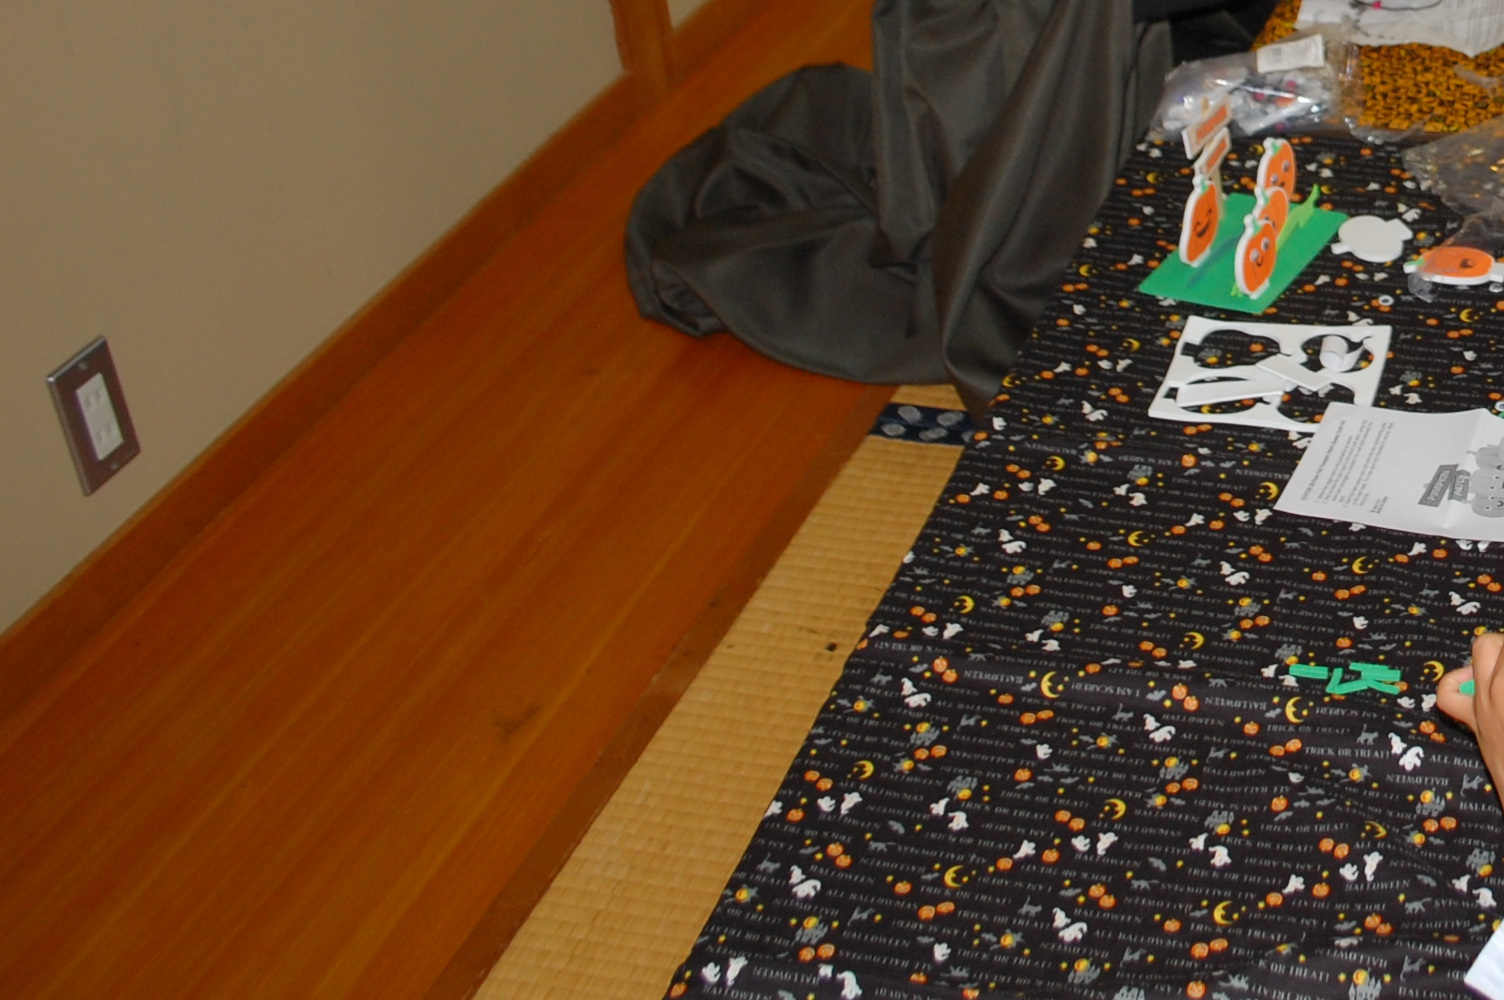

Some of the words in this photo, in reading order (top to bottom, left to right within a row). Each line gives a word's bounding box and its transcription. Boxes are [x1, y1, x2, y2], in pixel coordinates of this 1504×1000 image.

[963, 670, 1024, 684] HALLOWEEN
[1205, 696, 1267, 711] HALLOWEEN
[1338, 748, 1351, 758] OR
[1429, 753, 1450, 765] ALL
[1386, 773, 1449, 787] HALLOWEEN
